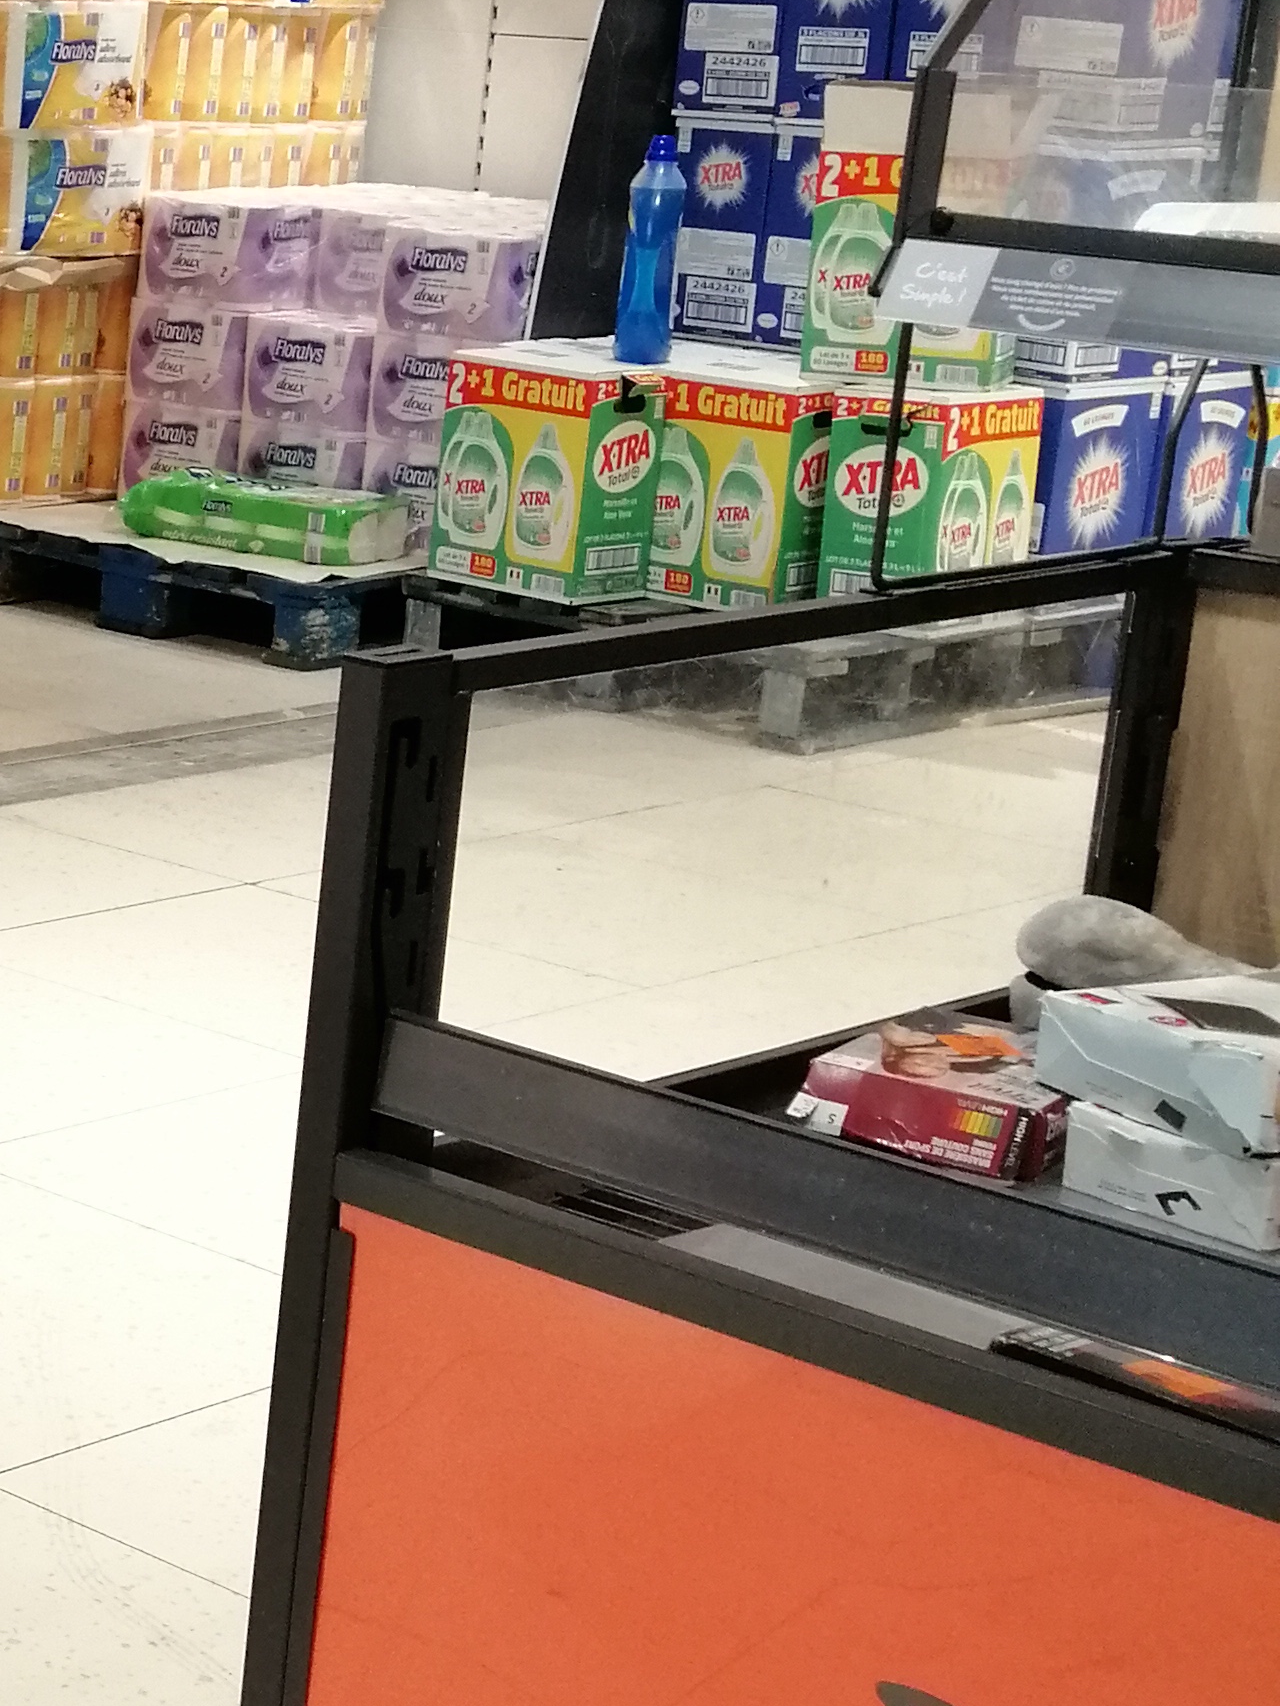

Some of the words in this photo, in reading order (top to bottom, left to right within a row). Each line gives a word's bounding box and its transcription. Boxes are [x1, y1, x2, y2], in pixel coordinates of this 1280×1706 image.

[712, 56, 766, 68] 2442426
[171, 215, 219, 239] Floralys
[172, 253, 203, 269] doux
[220, 266, 228, 278] 2
[411, 247, 467, 272] Floralys
[693, 280, 745, 293] 2442426
[414, 287, 448, 305] doux
[467, 302, 476, 315] 2
[155, 319, 203, 344] Floralys
[275, 339, 325, 363] Floralys
[276, 376, 307, 395] doux
[324, 393, 333, 405] 2
[503, 371, 586, 412] Gratuit
[698, 386, 786, 426] Gratuit
[985, 400, 1040, 435] Gratuit
[608, 471, 631, 487] Total
[828, 1113, 837, 1124] S
[1013, 1116, 1028, 1142] HIGH
